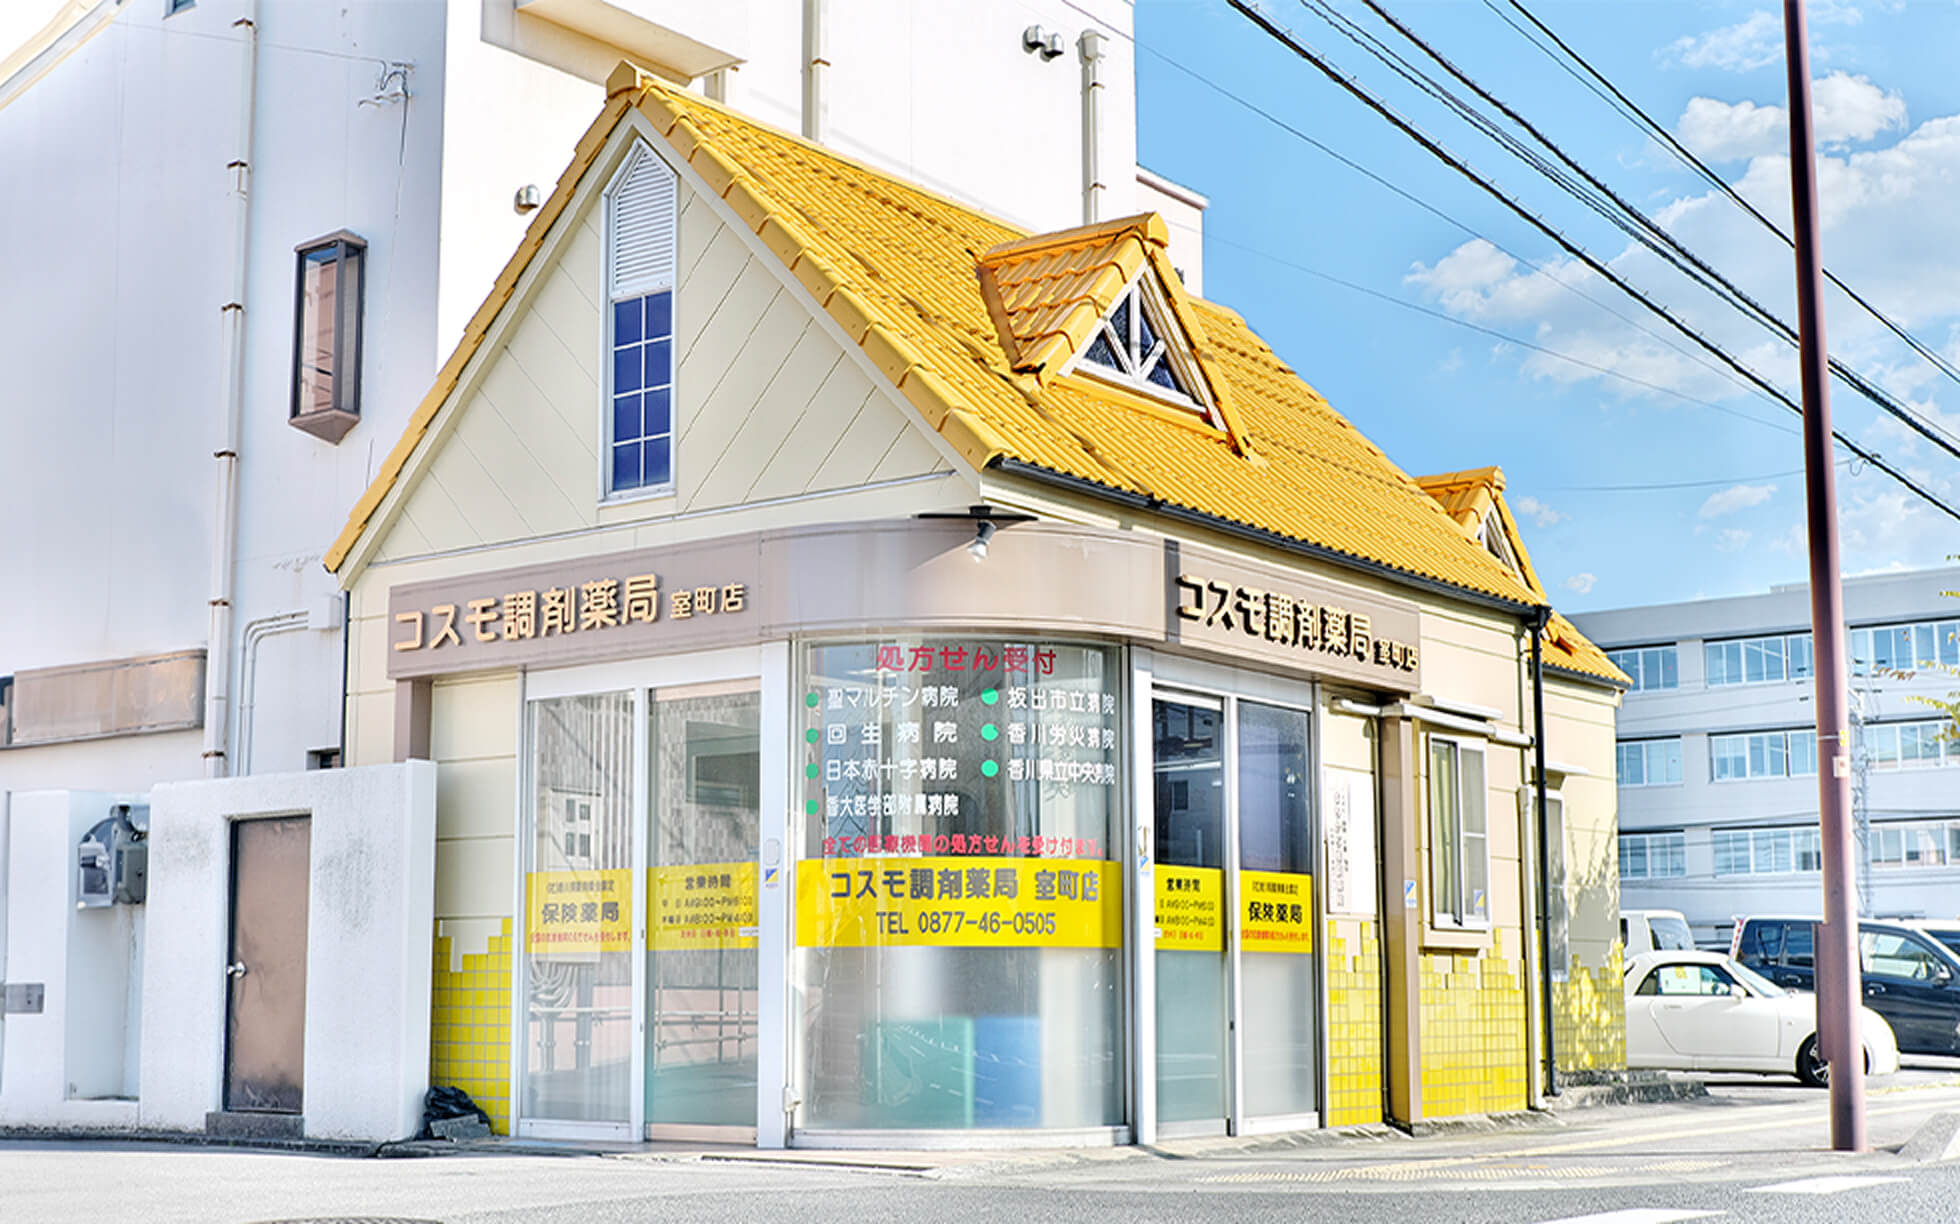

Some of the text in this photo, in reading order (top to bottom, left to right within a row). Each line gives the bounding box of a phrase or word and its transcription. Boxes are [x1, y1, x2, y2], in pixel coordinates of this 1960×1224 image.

[394, 573, 746, 651] コスモ調剤薬局 室町店
[1177, 574, 1372, 662] コスモ調剤薬局
[877, 645, 1057, 675] 処方せん受付
[826, 685, 959, 710] 聖マルチン病院
[1007, 686, 1115, 715] 坂出市立病院
[1007, 722, 1115, 749] 香川労災病院
[826, 757, 957, 781] 日本赤十字病院
[1007, 758, 1115, 785] 香川県立中央病院
[830, 867, 1099, 901] コスモ調剤薬局 室町店
[876, 910, 1056, 935] TEL 0877-46-0505
